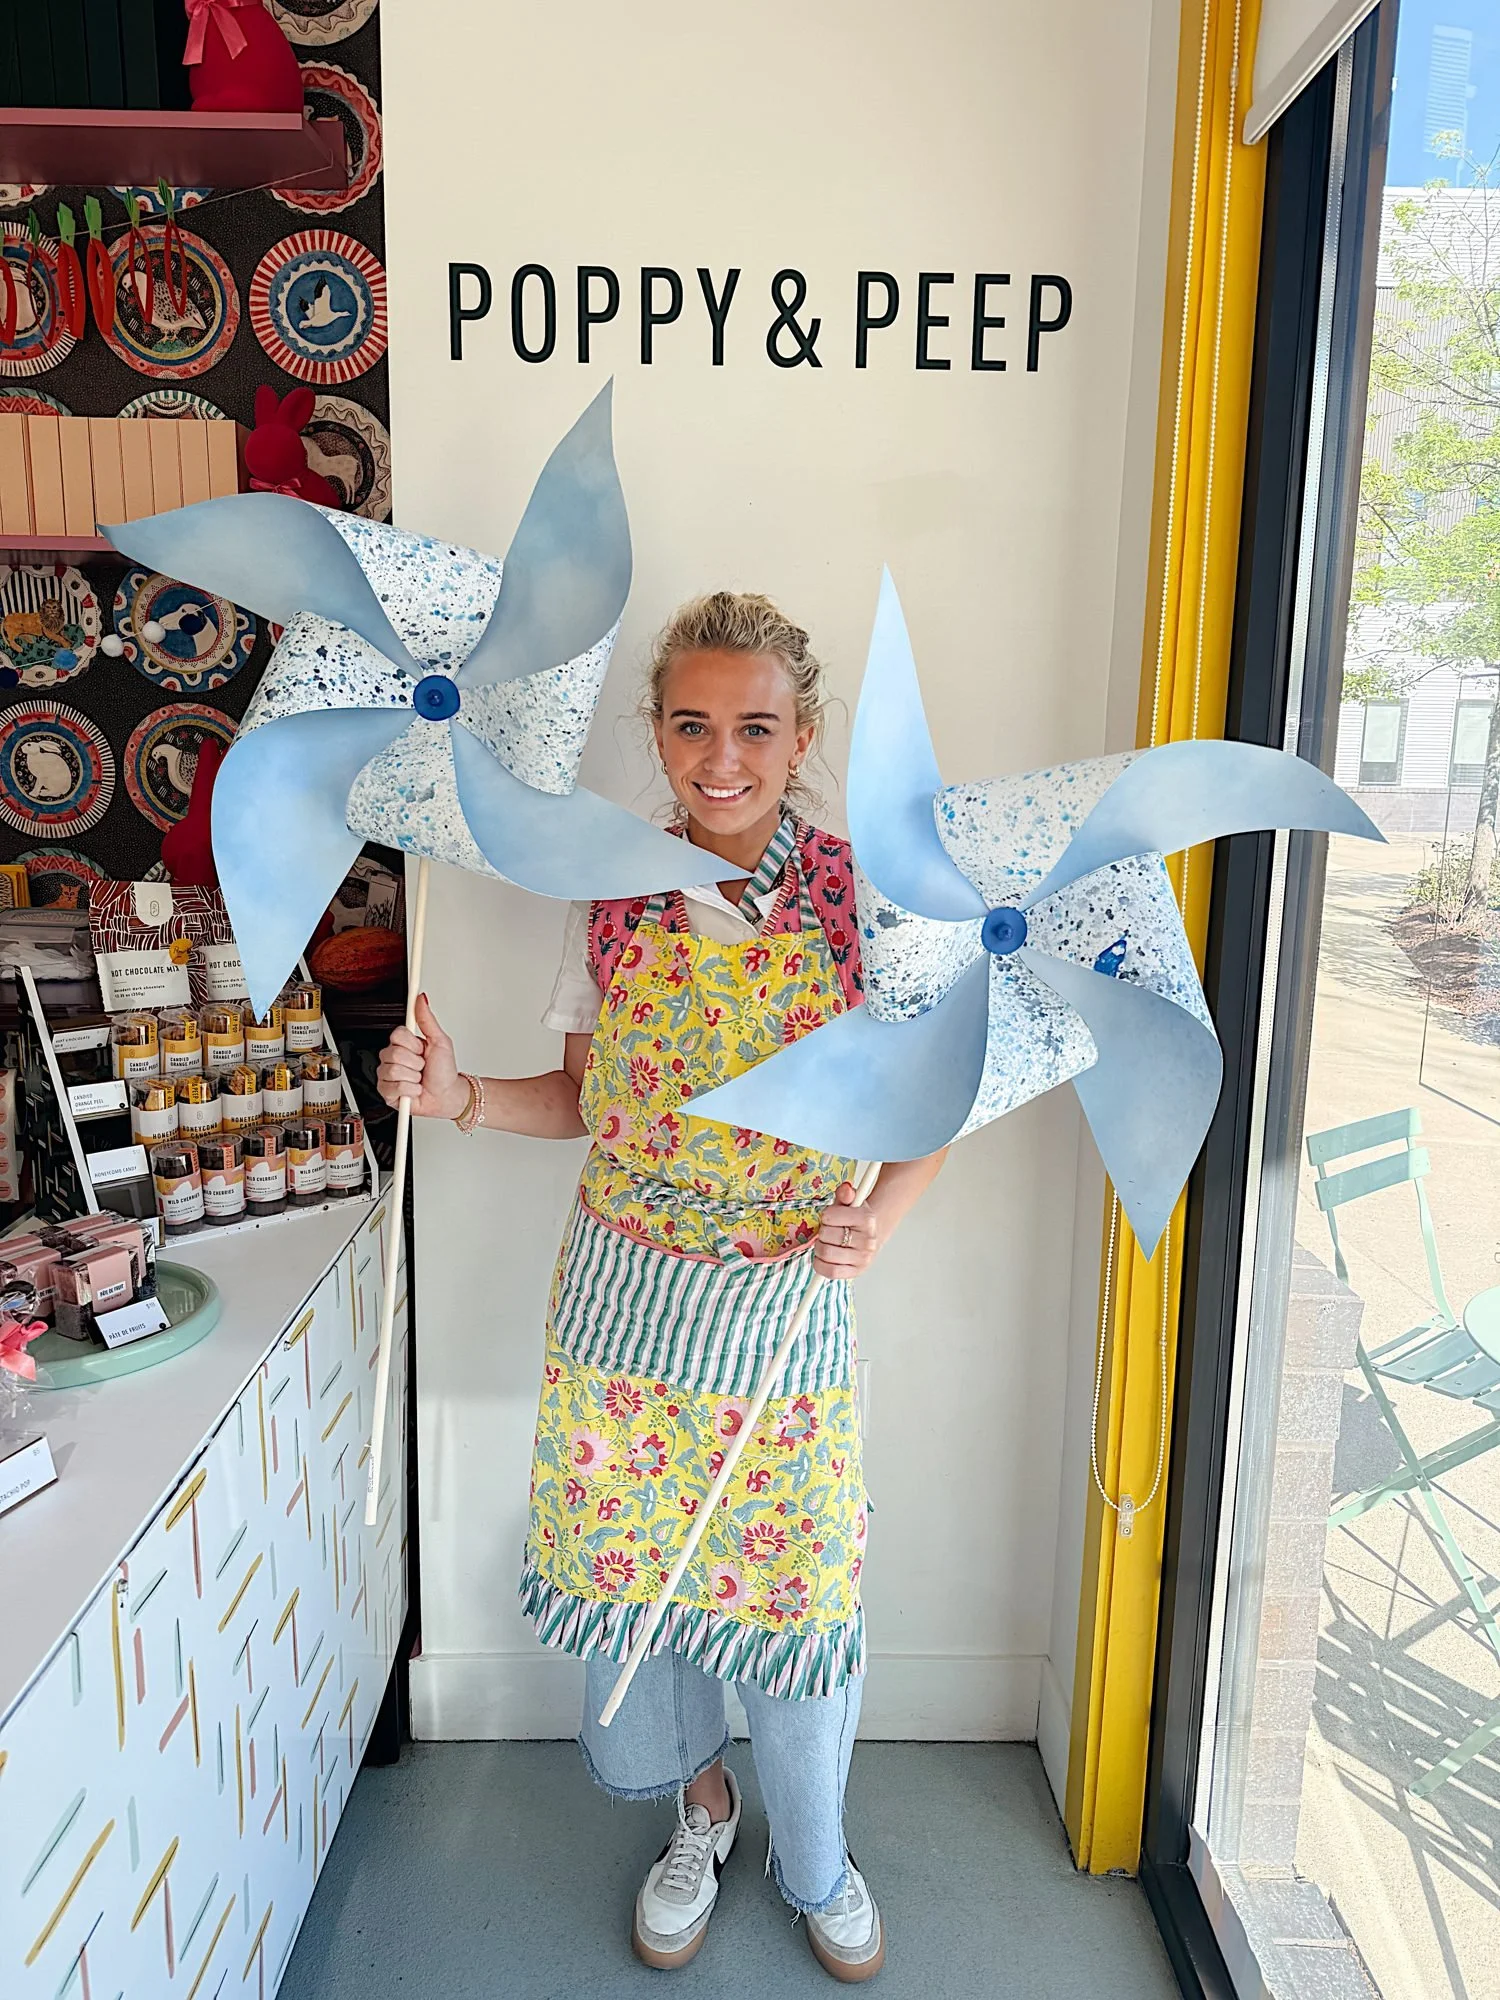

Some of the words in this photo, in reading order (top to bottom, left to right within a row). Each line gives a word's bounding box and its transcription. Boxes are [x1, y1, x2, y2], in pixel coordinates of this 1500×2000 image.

[449, 263, 741, 366] POPPY
[766, 269, 823, 368] &
[855, 271, 1072, 372] PEEP
[125, 966, 164, 976] CHOCOLATE
[304, 1099, 338, 1108] HONEYCOMB
[182, 1122, 218, 1132] HONEYCOMB
[94, 1169, 122, 1178] HONEYCOMB
[181, 1193, 200, 1203] CHERRIES
[129, 1323, 146, 1333] FRUITS
[20, 1479, 30, 1490] POP
